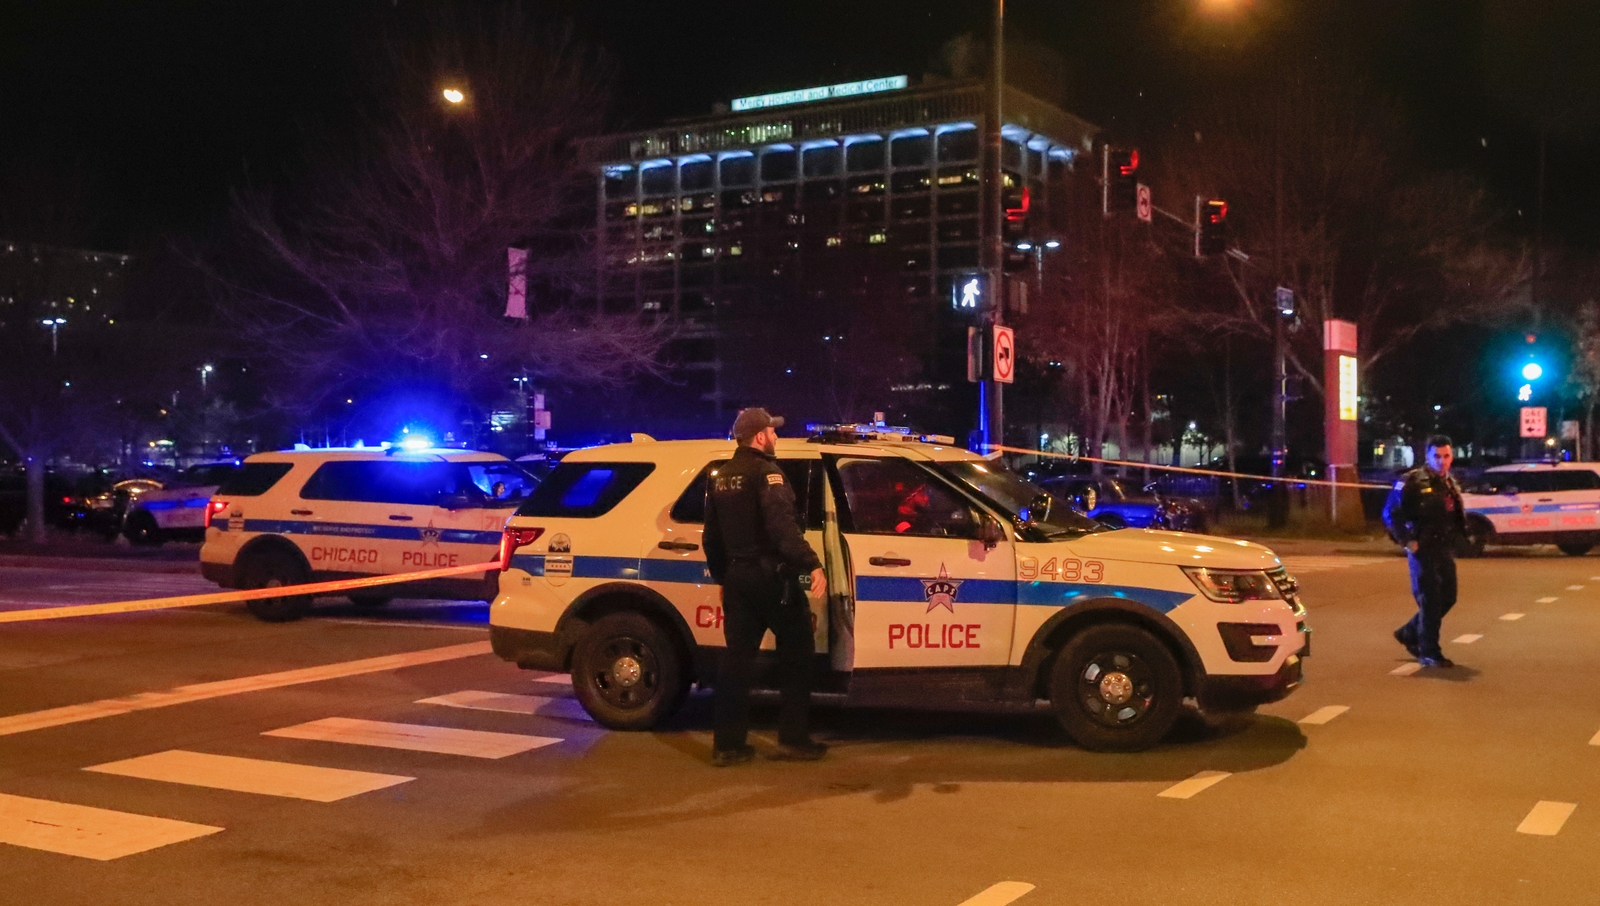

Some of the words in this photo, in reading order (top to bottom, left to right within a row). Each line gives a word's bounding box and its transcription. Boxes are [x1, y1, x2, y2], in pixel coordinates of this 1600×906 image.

[739, 98, 765, 108] Mercy
[768, 92, 804, 106] Hospital
[807, 89, 825, 99] and
[828, 83, 863, 96] Medical
[866, 79, 898, 91] Center
[311, 547, 378, 564] CHICAGO
[402, 551, 458, 567] POLICE
[1019, 556, 1104, 583] 9483
[927, 584, 956, 596] CAPS
[888, 624, 981, 649] POLICE
